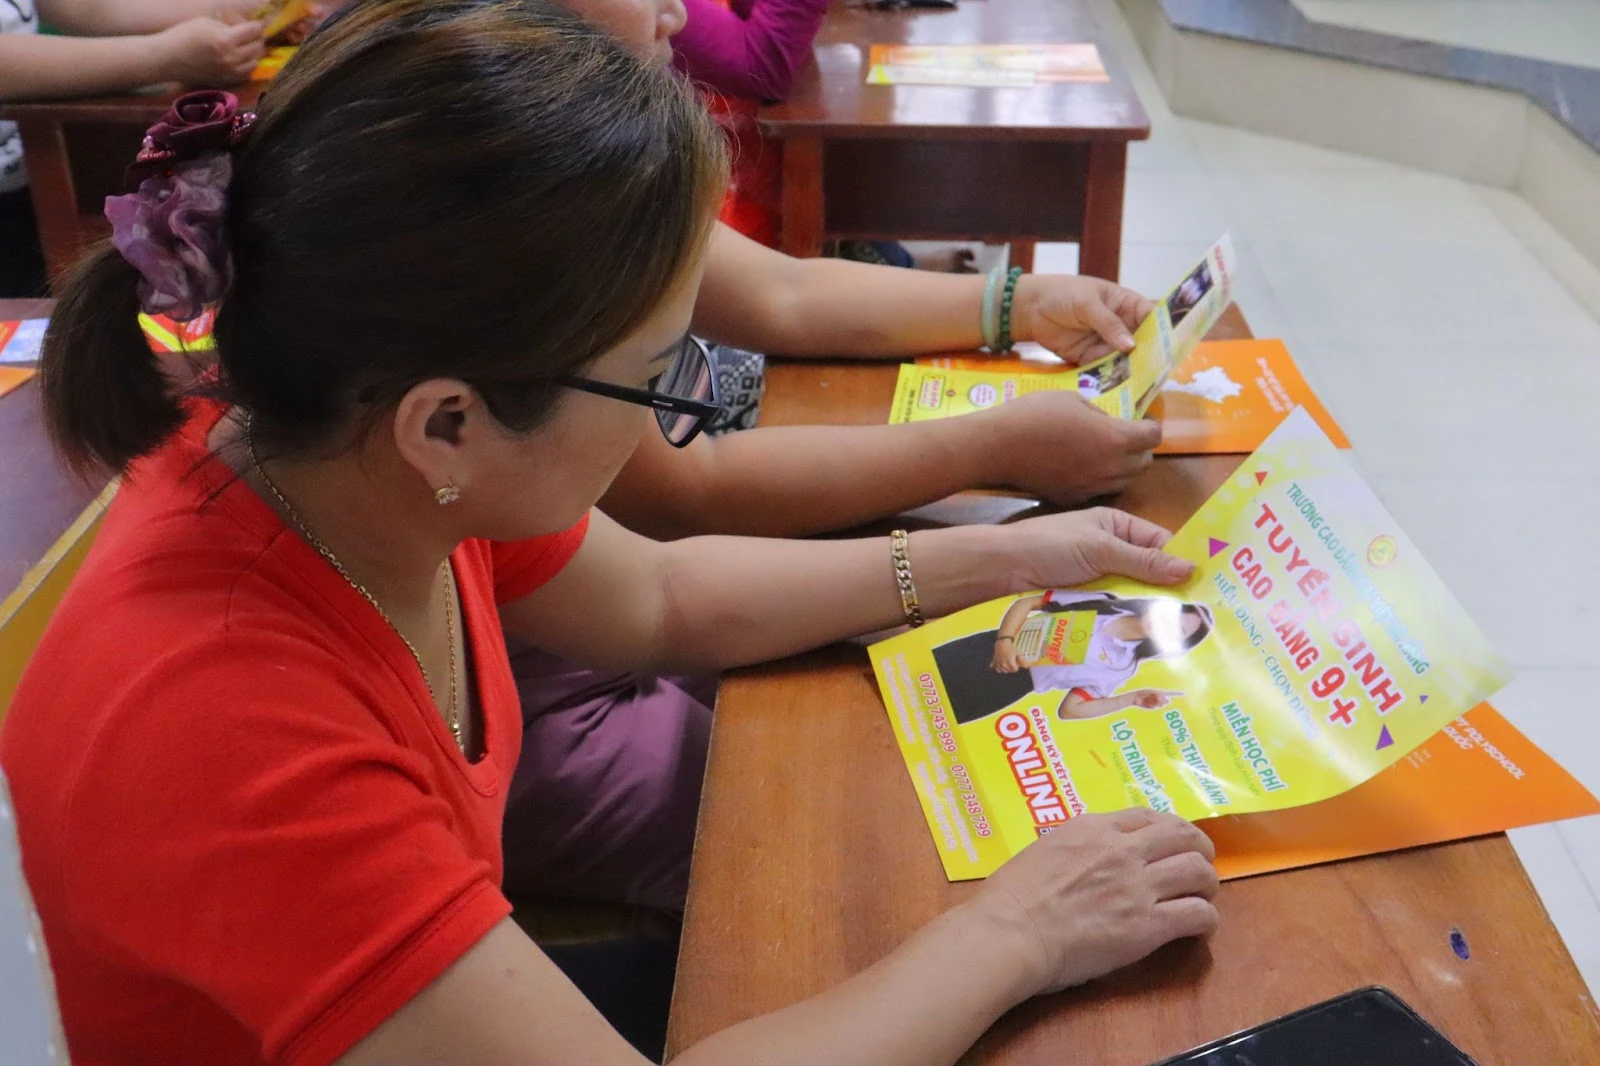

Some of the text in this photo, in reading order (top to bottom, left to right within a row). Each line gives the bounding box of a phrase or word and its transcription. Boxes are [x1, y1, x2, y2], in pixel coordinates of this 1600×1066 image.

[1284, 481, 1325, 531] TRƯỜNG
[1315, 524, 1340, 552] CAO
[1230, 545, 1277, 602] CAO
[1307, 662, 1356, 725] 9+
[1262, 654, 1294, 697] CHỌN
[1330, 618, 1403, 713] SINH
[918, 671, 939, 706] 0773
[929, 706, 948, 730] 745
[1163, 708, 1191, 745] 80%
[937, 730, 956, 753] 999
[1030, 706, 1051, 743] ĐĂNG
[1045, 743, 1059, 758] KÝ
[1052, 760, 1067, 781] XÉT
[1120, 740, 1150, 781] TRÌNH
[1462, 725, 1525, 780] POLYSCHOOL
[950, 763, 971, 791] 0777
[998, 714, 1066, 825] ONLINE
[1240, 736, 1269, 769] HỌC
[1256, 766, 1286, 792] PHÍ
[961, 792, 980, 815] 348
[971, 814, 991, 838] 799
